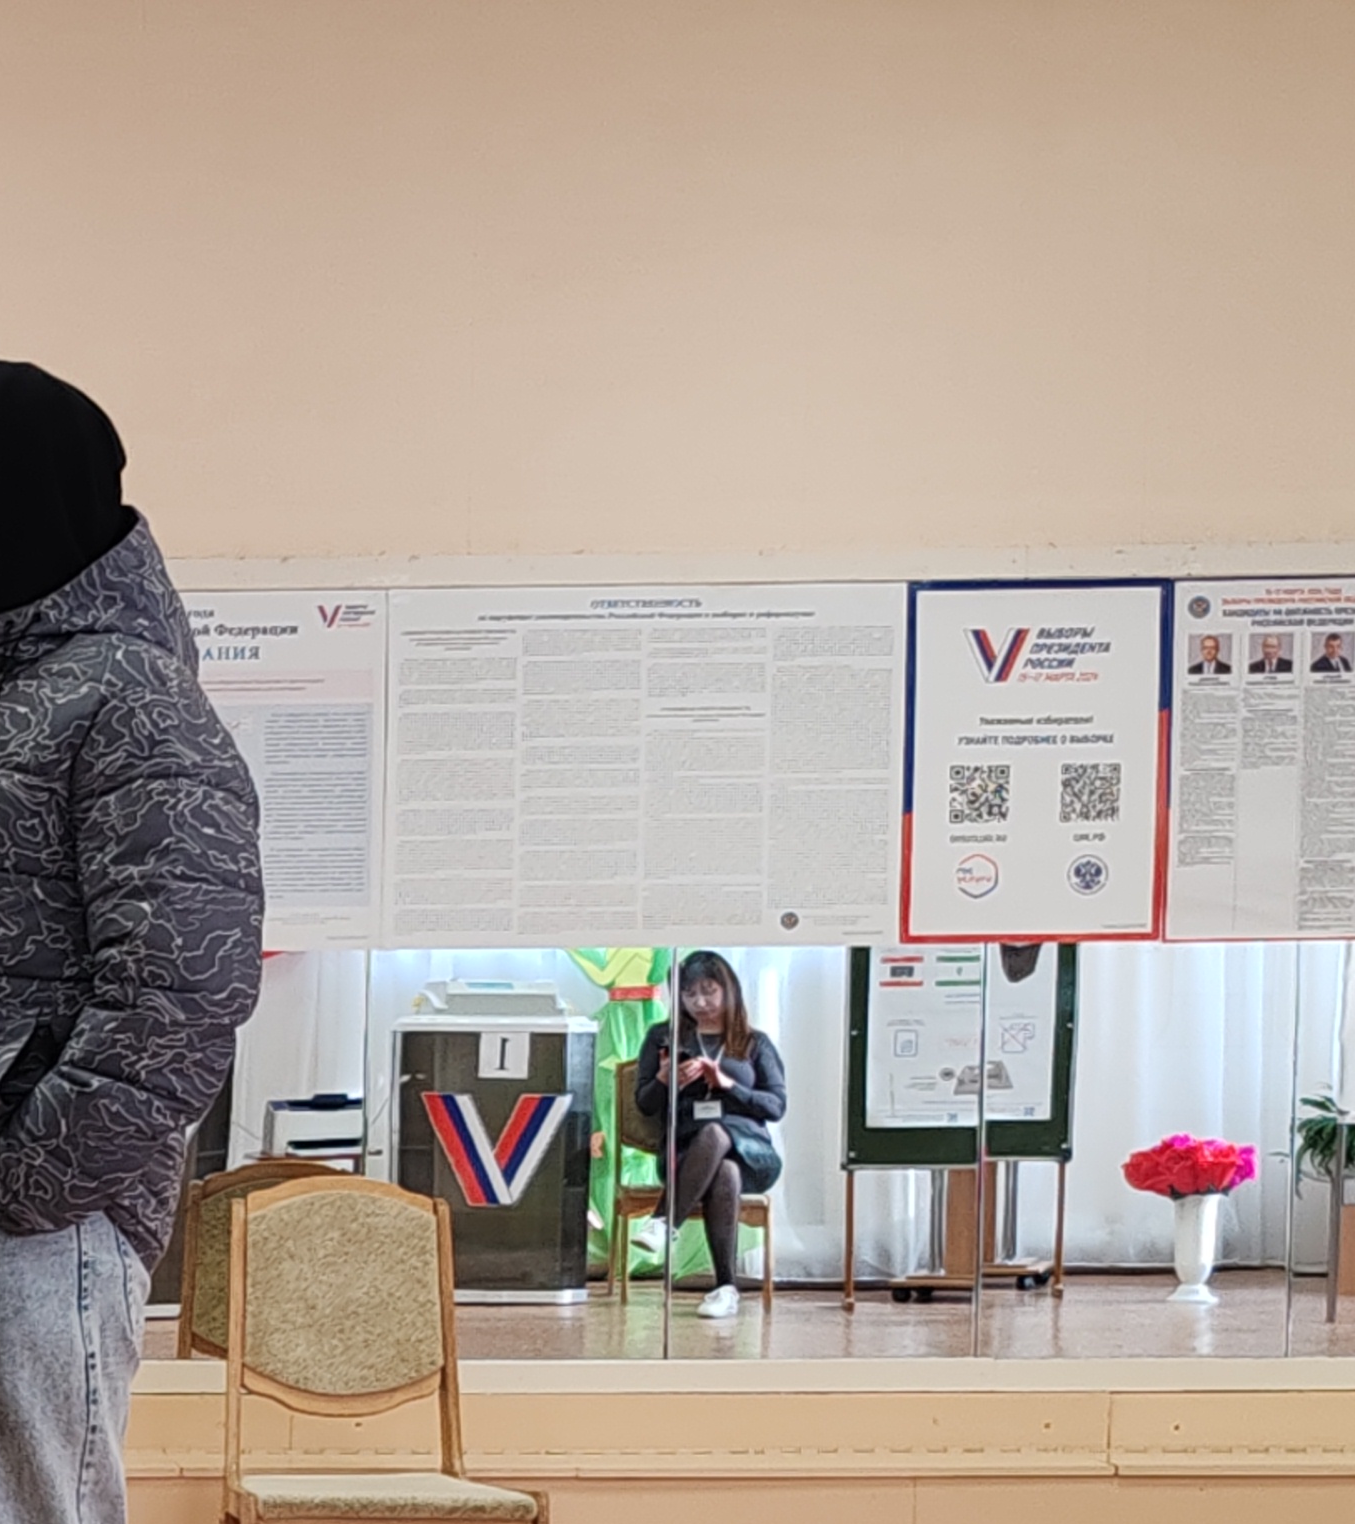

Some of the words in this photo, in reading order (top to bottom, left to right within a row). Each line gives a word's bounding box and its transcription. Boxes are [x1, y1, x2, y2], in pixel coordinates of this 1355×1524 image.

[214, 623, 299, 639] Федерации
[1036, 626, 1095, 639] ВЫБОРЫ
[1029, 642, 1112, 655] ПРЕЗИДЕНТА
[1022, 657, 1076, 669] РОССИИ
